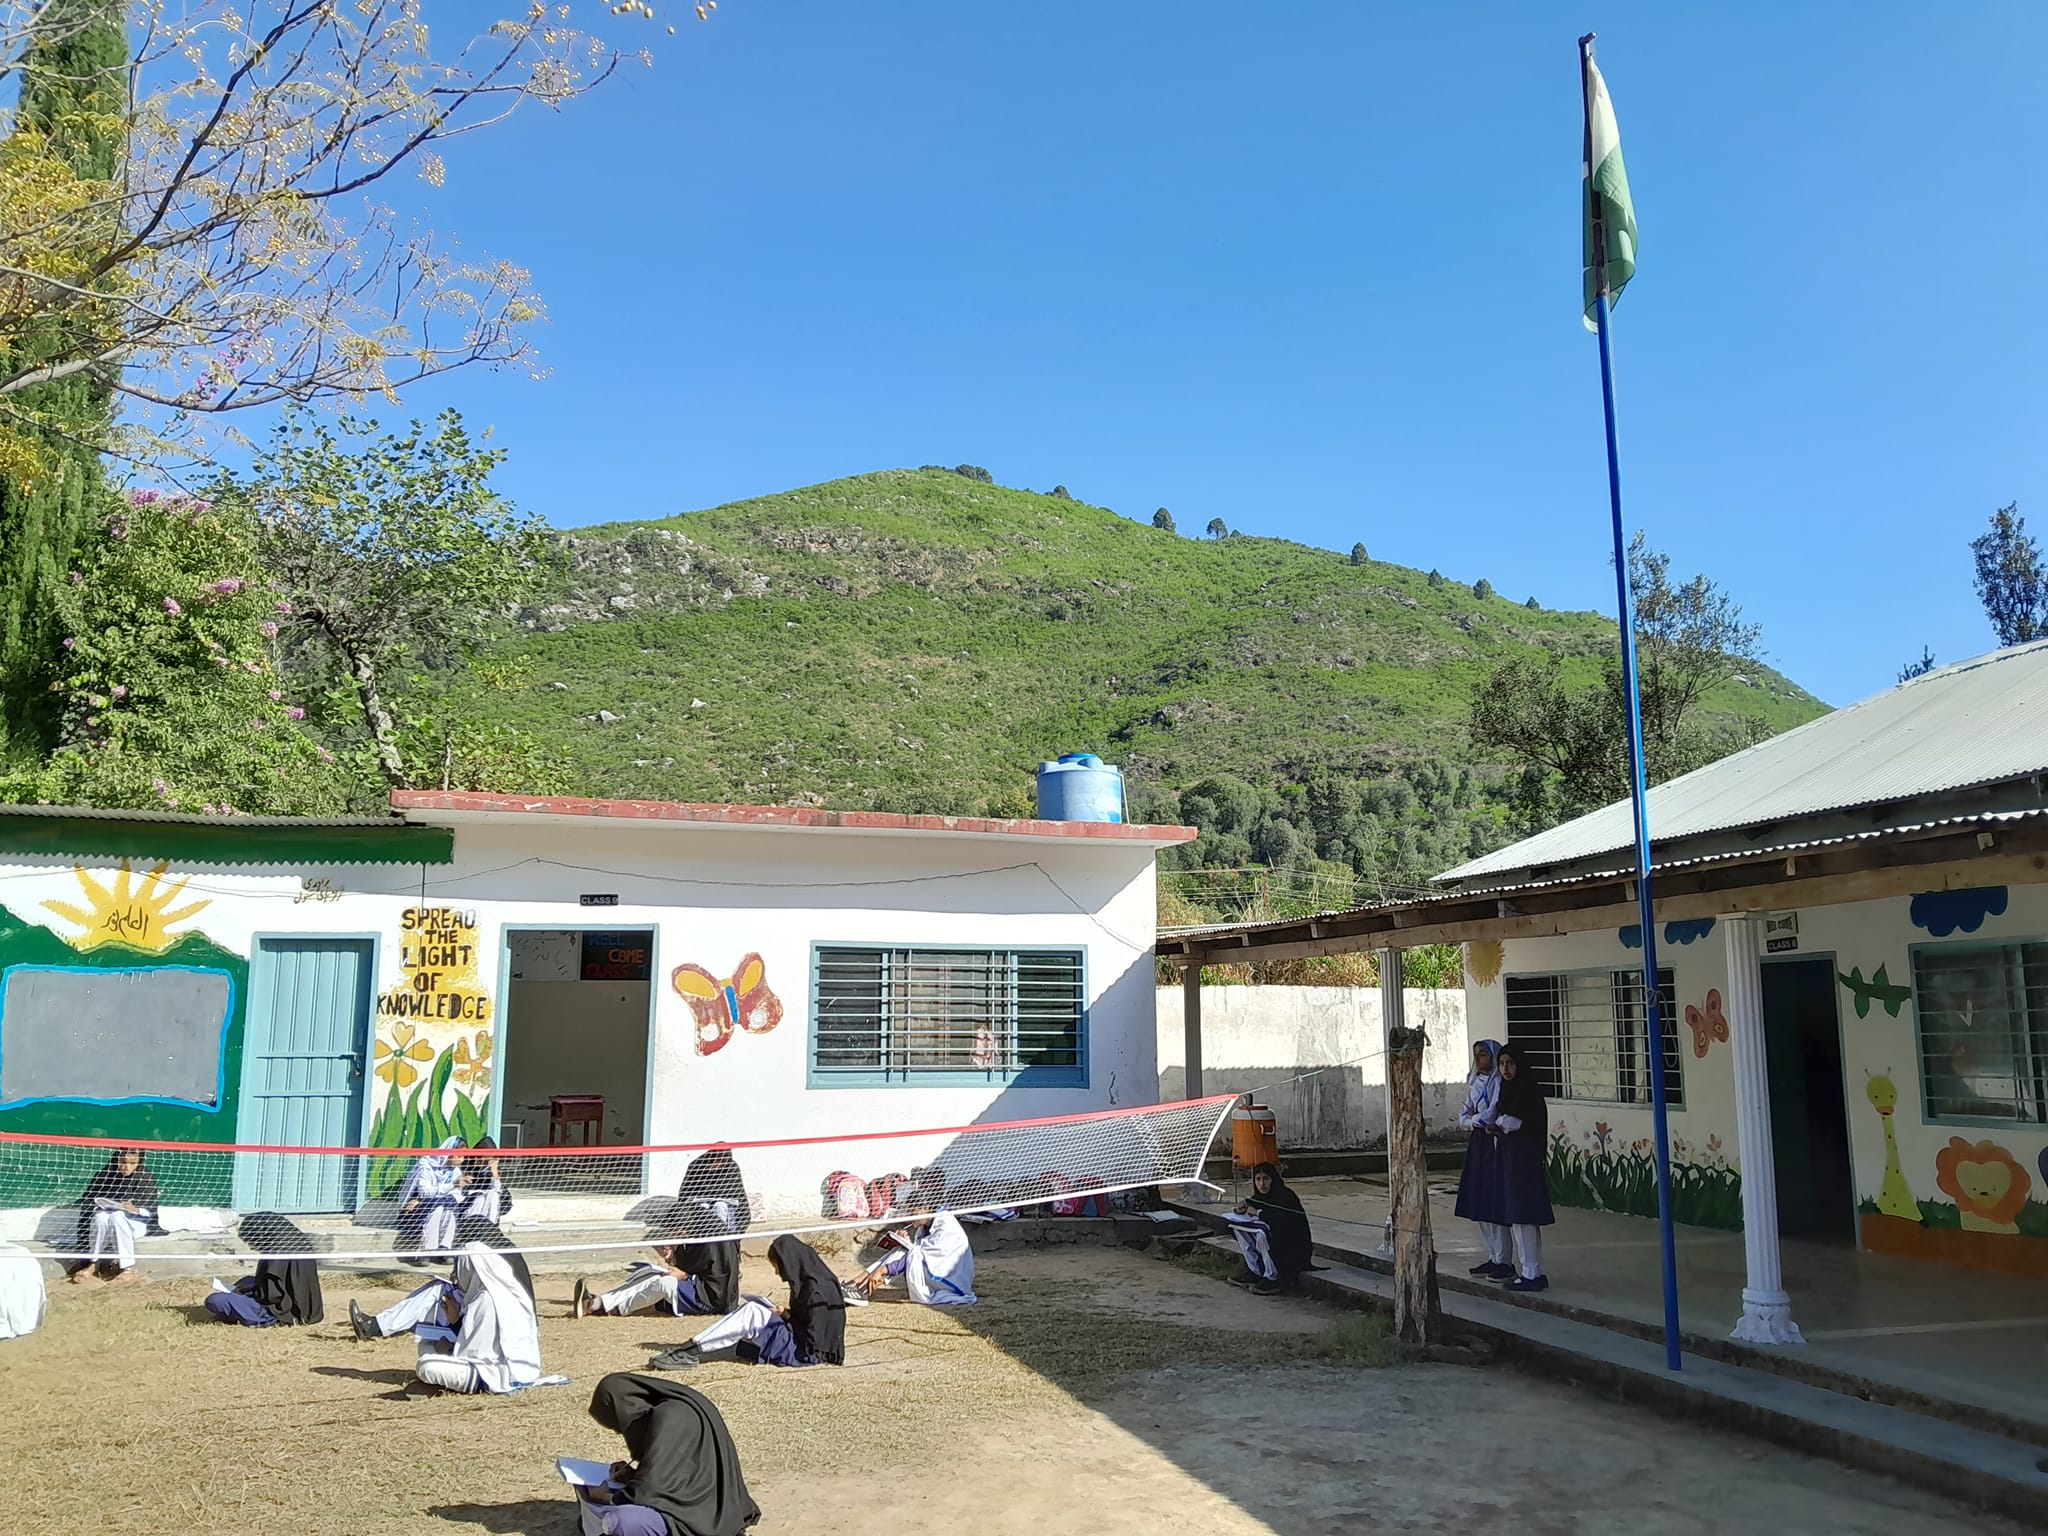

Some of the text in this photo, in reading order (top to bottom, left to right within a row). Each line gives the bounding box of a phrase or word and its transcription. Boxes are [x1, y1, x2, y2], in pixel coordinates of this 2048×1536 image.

[581, 896, 611, 905] CLASS
[424, 929, 458, 945] THE
[1767, 939, 1791, 951] CLASS
[402, 945, 472, 968] LIGHT
[608, 948, 645, 964] COME
[413, 972, 443, 992] OF
[376, 993, 487, 1020] KNOWLEDGE
